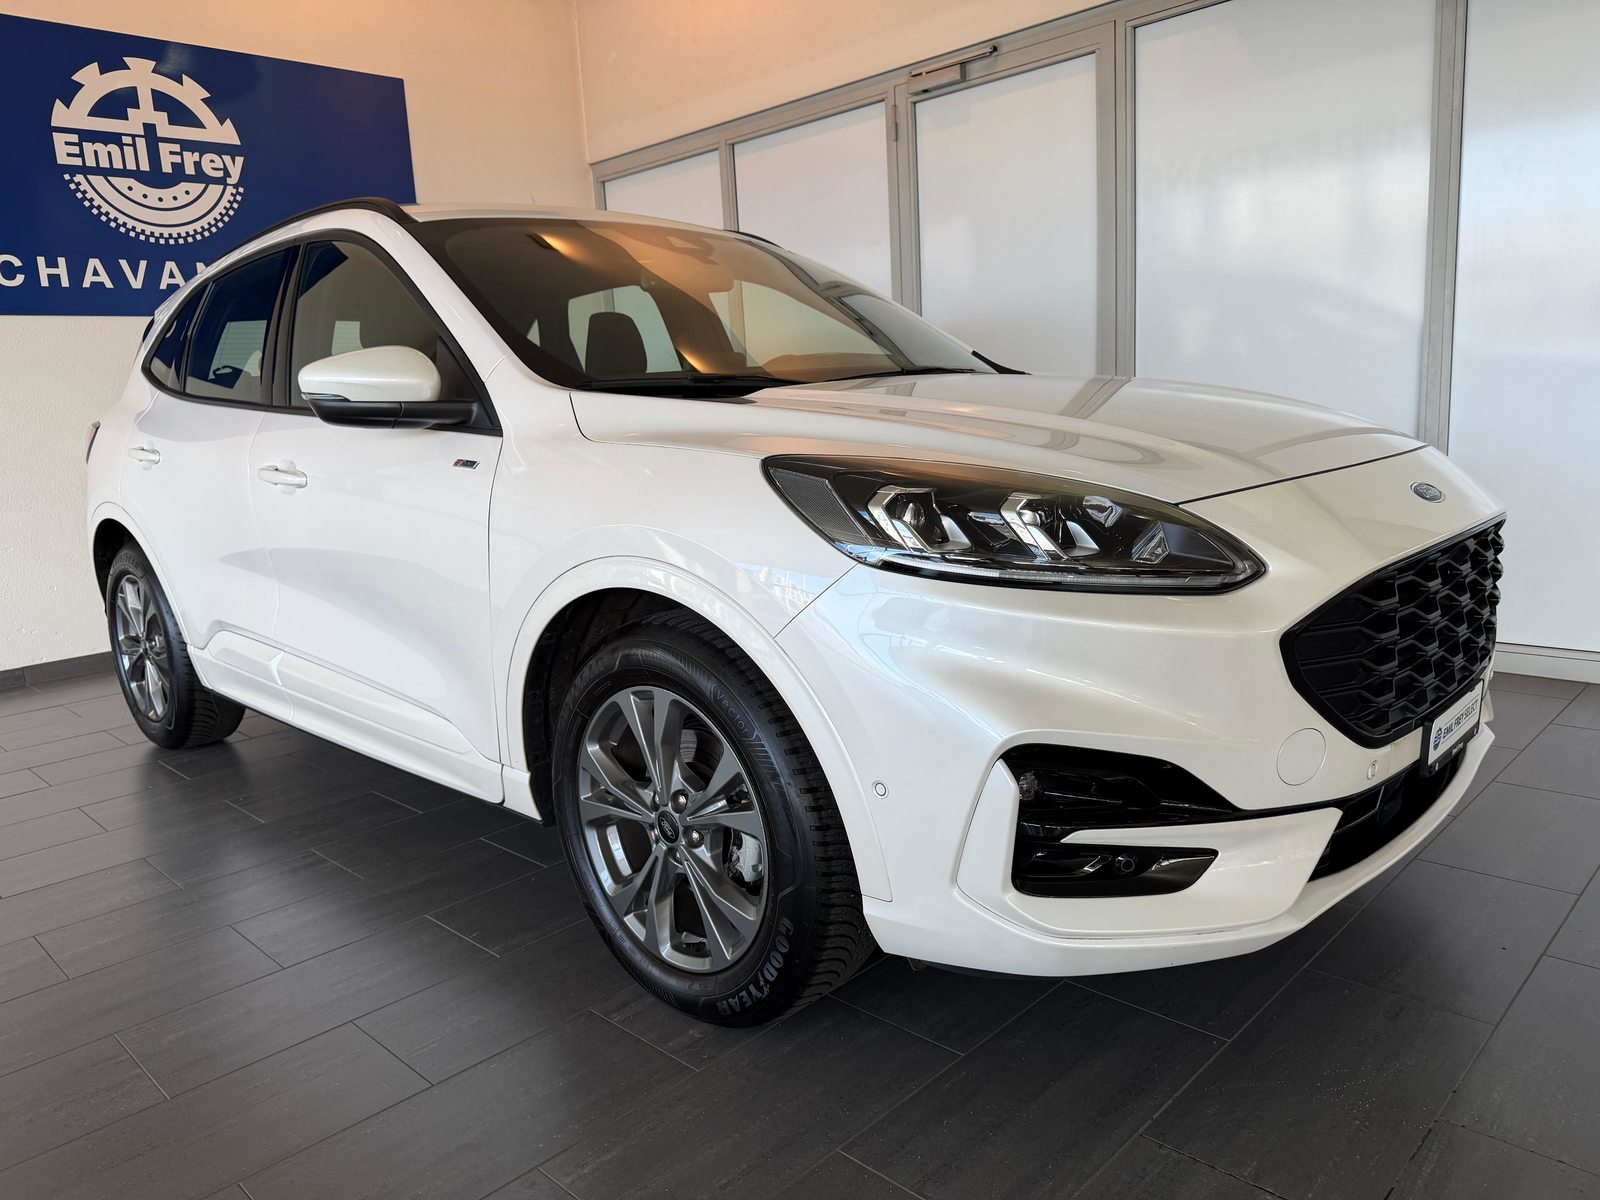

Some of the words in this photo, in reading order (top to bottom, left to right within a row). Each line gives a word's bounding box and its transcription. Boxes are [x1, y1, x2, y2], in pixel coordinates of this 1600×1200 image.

[52, 132, 150, 172] Emil
[158, 142, 245, 185] Frey
[0, 254, 207, 290] CHAVA
[1442, 723, 1455, 739] EMIL
[1454, 712, 1465, 729] FREY
[1464, 699, 1479, 720] SELECT
[715, 917, 795, 1016] GOODYEAR
